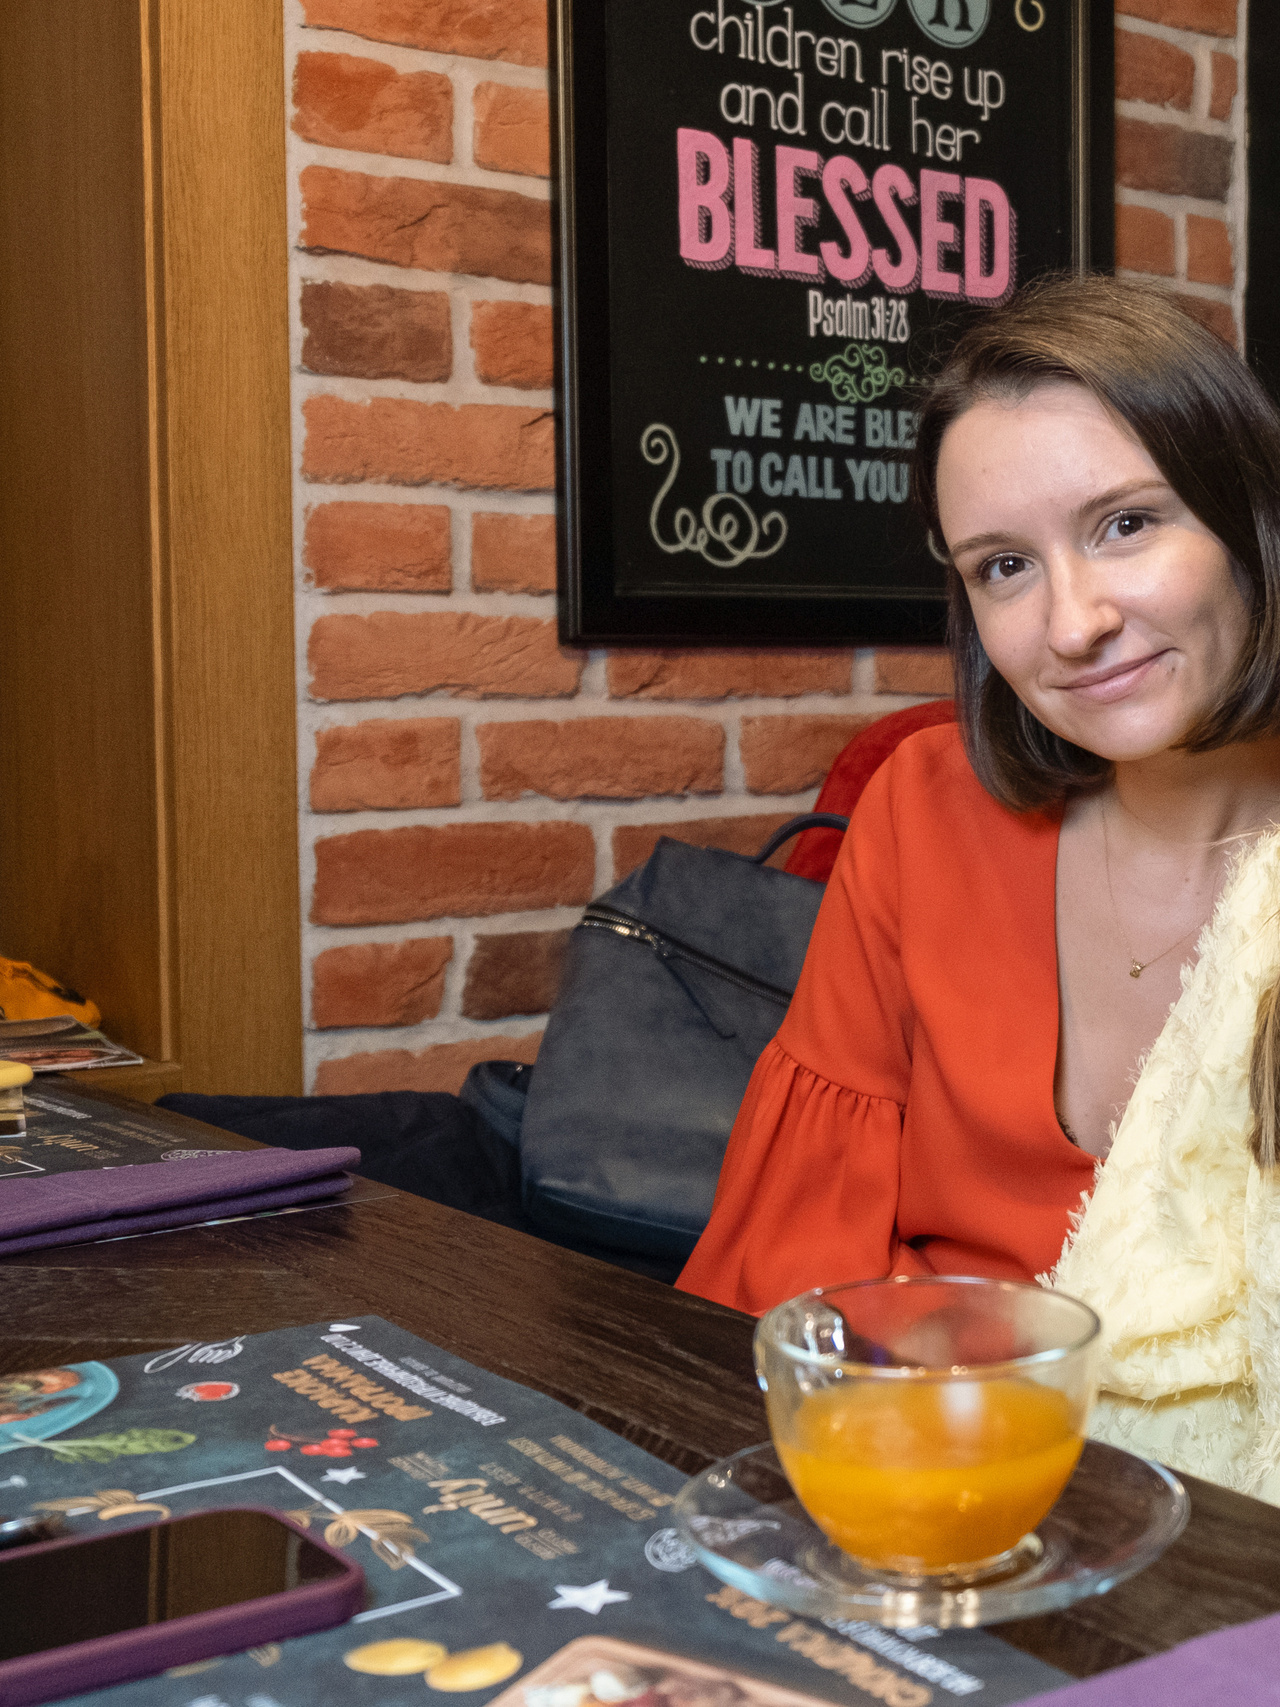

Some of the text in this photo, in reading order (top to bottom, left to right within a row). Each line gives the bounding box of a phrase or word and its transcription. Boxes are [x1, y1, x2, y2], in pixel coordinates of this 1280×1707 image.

[690, 0, 864, 83] children
[882, 48, 953, 100] rise
[964, 65, 1006, 121] up
[720, 73, 981, 161] and call her
[677, 127, 1017, 307] BLESSED
[724, 395, 919, 449] WE ARE BLE
[710, 448, 911, 503] TO CALL YOU
